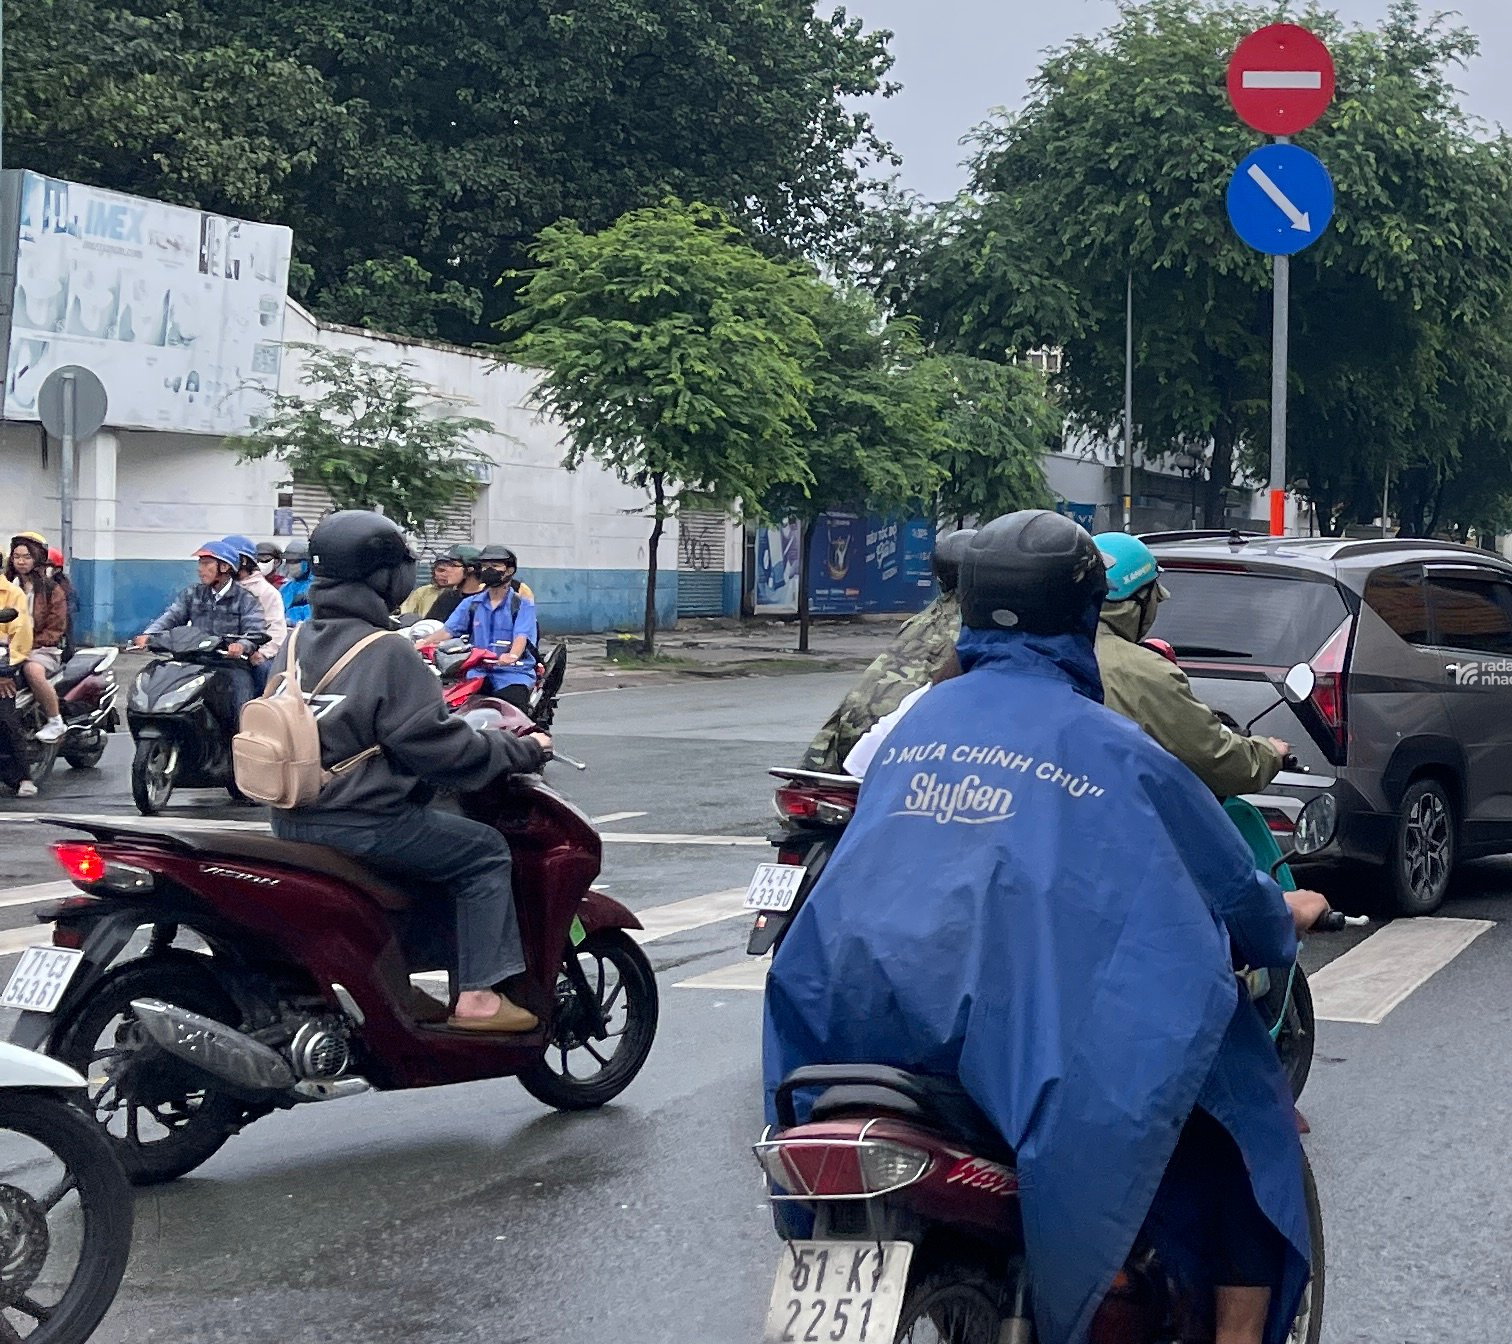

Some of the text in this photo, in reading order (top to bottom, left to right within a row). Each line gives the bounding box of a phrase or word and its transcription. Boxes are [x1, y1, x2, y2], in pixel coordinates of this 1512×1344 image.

[897, 741, 947, 764] MƯA
[952, 744, 1033, 773] CHÍNH
[904, 772, 1014, 824] SkyGen
[782, 1298, 873, 1343] 2251
